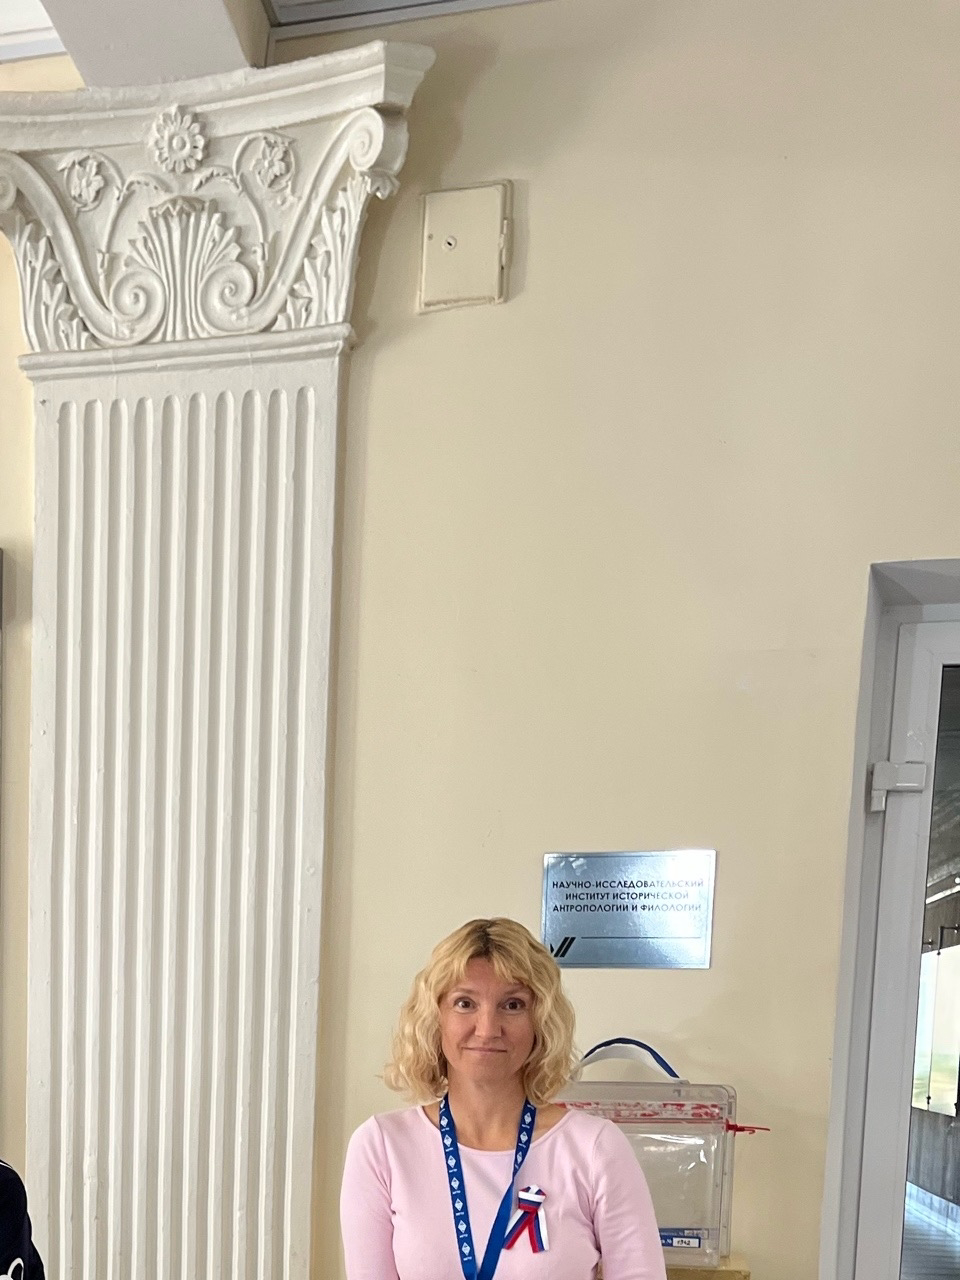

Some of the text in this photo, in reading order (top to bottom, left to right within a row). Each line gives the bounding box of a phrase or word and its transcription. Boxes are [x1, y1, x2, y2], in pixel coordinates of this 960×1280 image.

[552, 878, 704, 890] НАУЧНО-ИССЛЕДОВАТЕЛЬСКИЙ
[565, 890, 690, 901] ИНСТИТУТ ИСТОРИЧЕСКОЙ
[552, 904, 702, 913] АНТРОПОЛОГИИ И ФИЛОЛОГИИ
